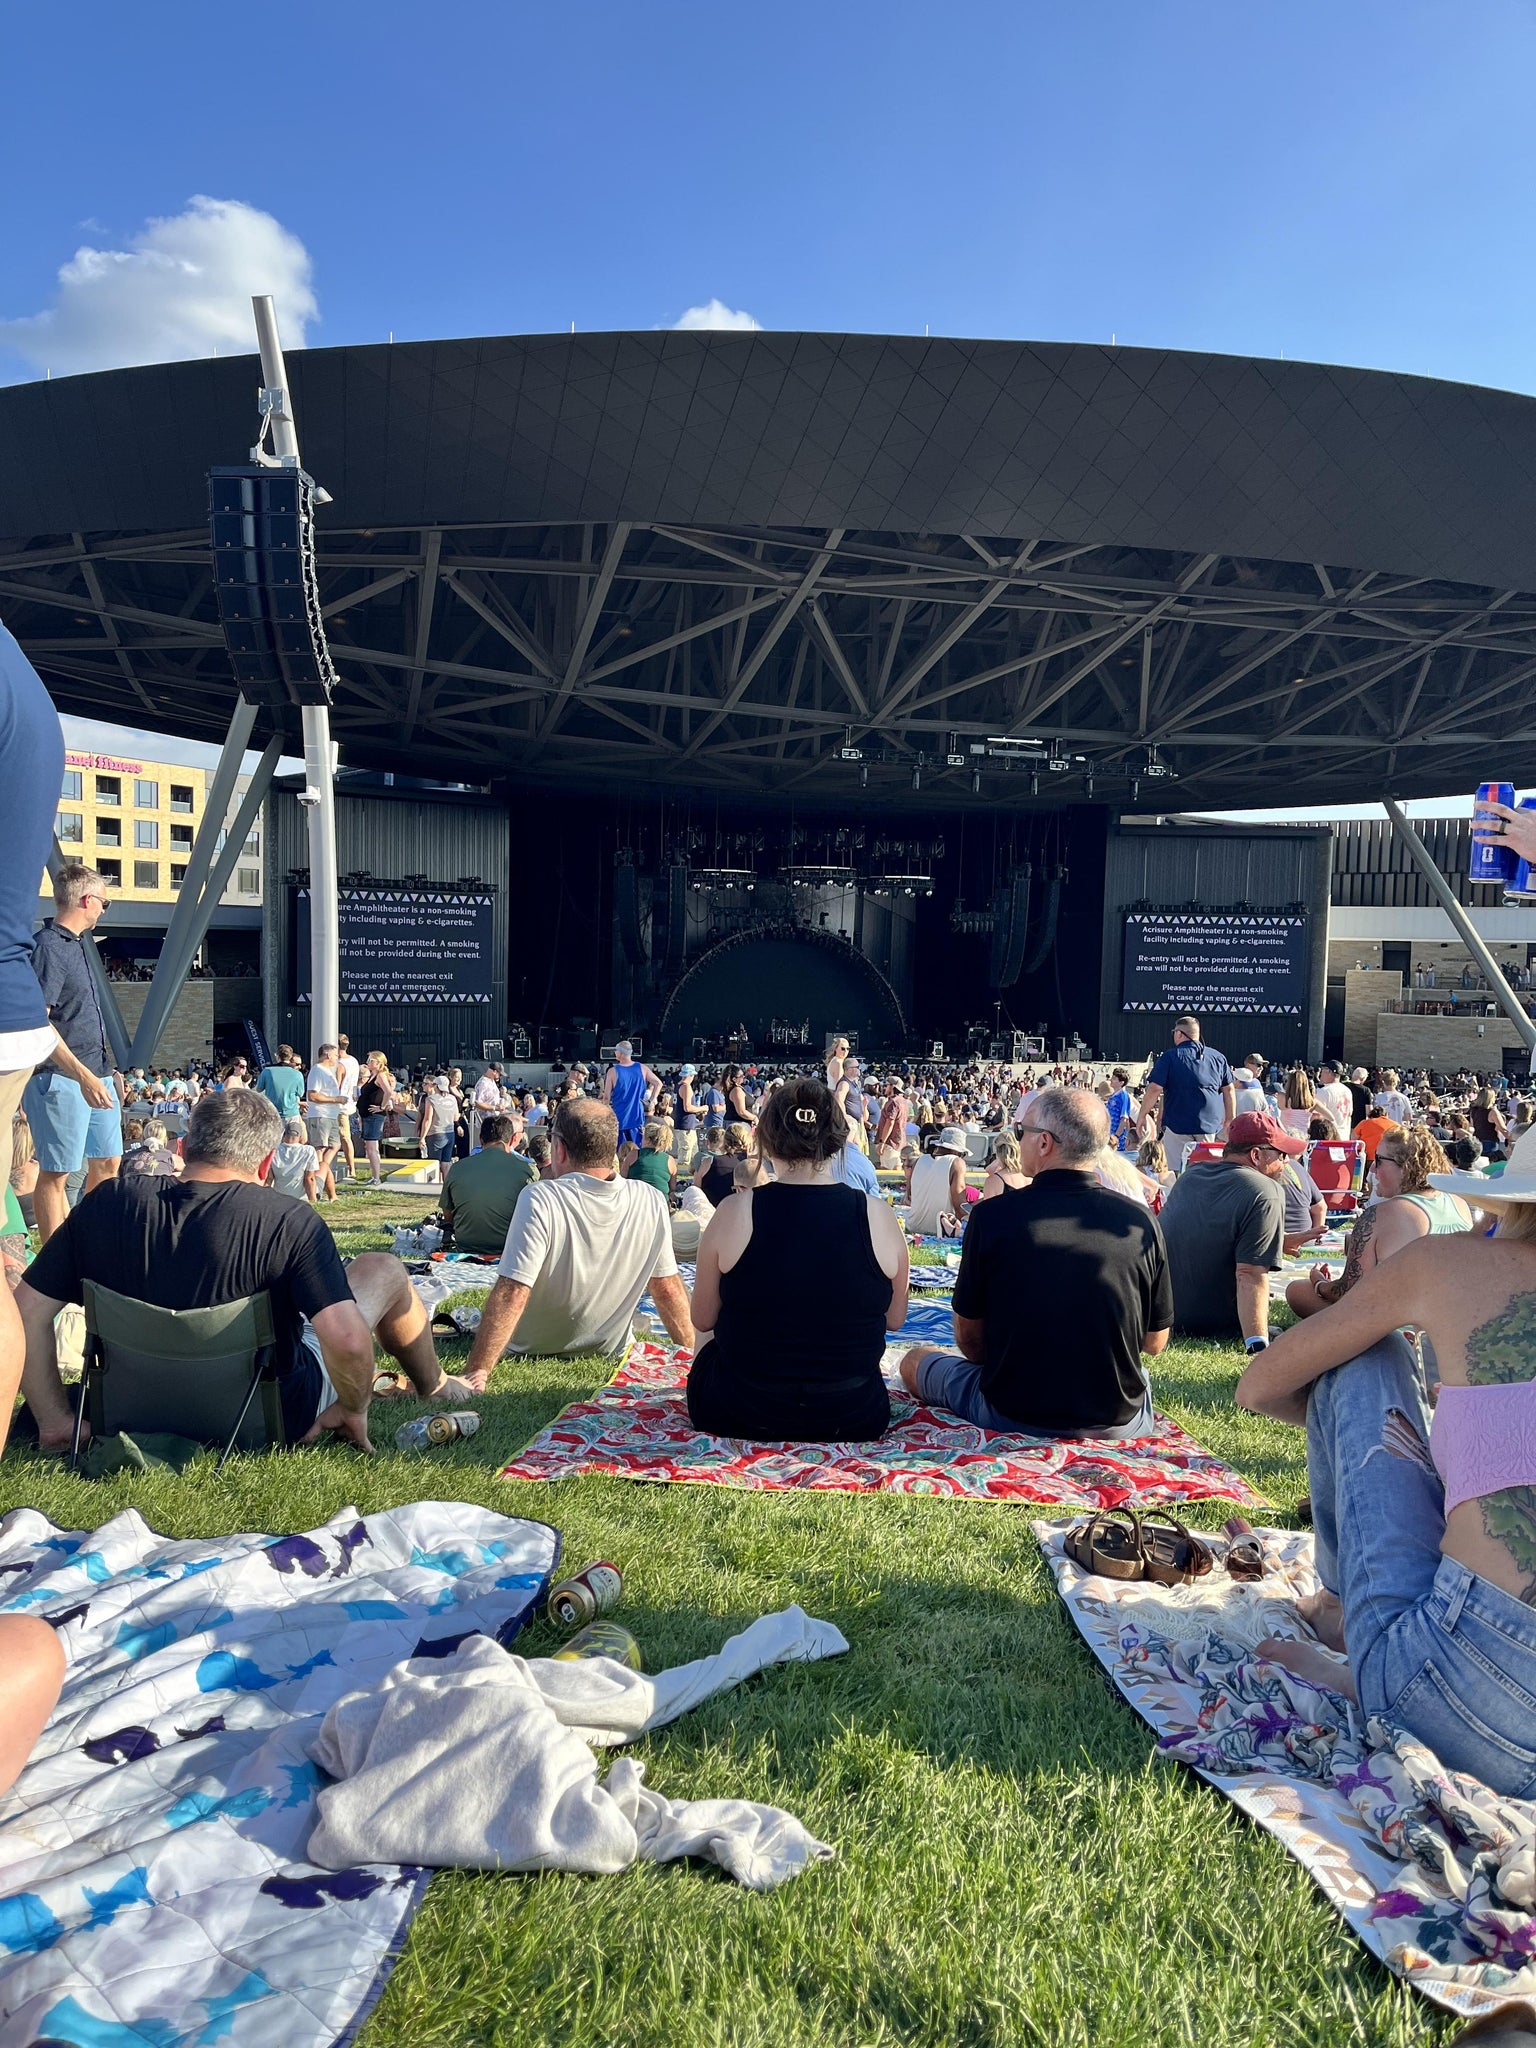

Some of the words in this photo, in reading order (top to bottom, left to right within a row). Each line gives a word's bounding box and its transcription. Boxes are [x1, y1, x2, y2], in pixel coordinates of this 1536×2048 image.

[354, 904, 409, 914] Amphitheater
[428, 908, 476, 916] non-smoking
[349, 916, 387, 925] including
[389, 917, 416, 926] vaping
[427, 918, 474, 926] e-cigarettes.
[1175, 927, 1224, 936] Amphitheater
[396, 939, 437, 948] permitted.
[448, 940, 479, 948] smoking
[378, 949, 413, 958] provided
[416, 950, 441, 959] during
[1139, 955, 1169, 963] Re-entry
[1260, 957, 1290, 966] smoking
[1195, 966, 1227, 974] provided
[248, 1020, 258, 1040] GUEST
